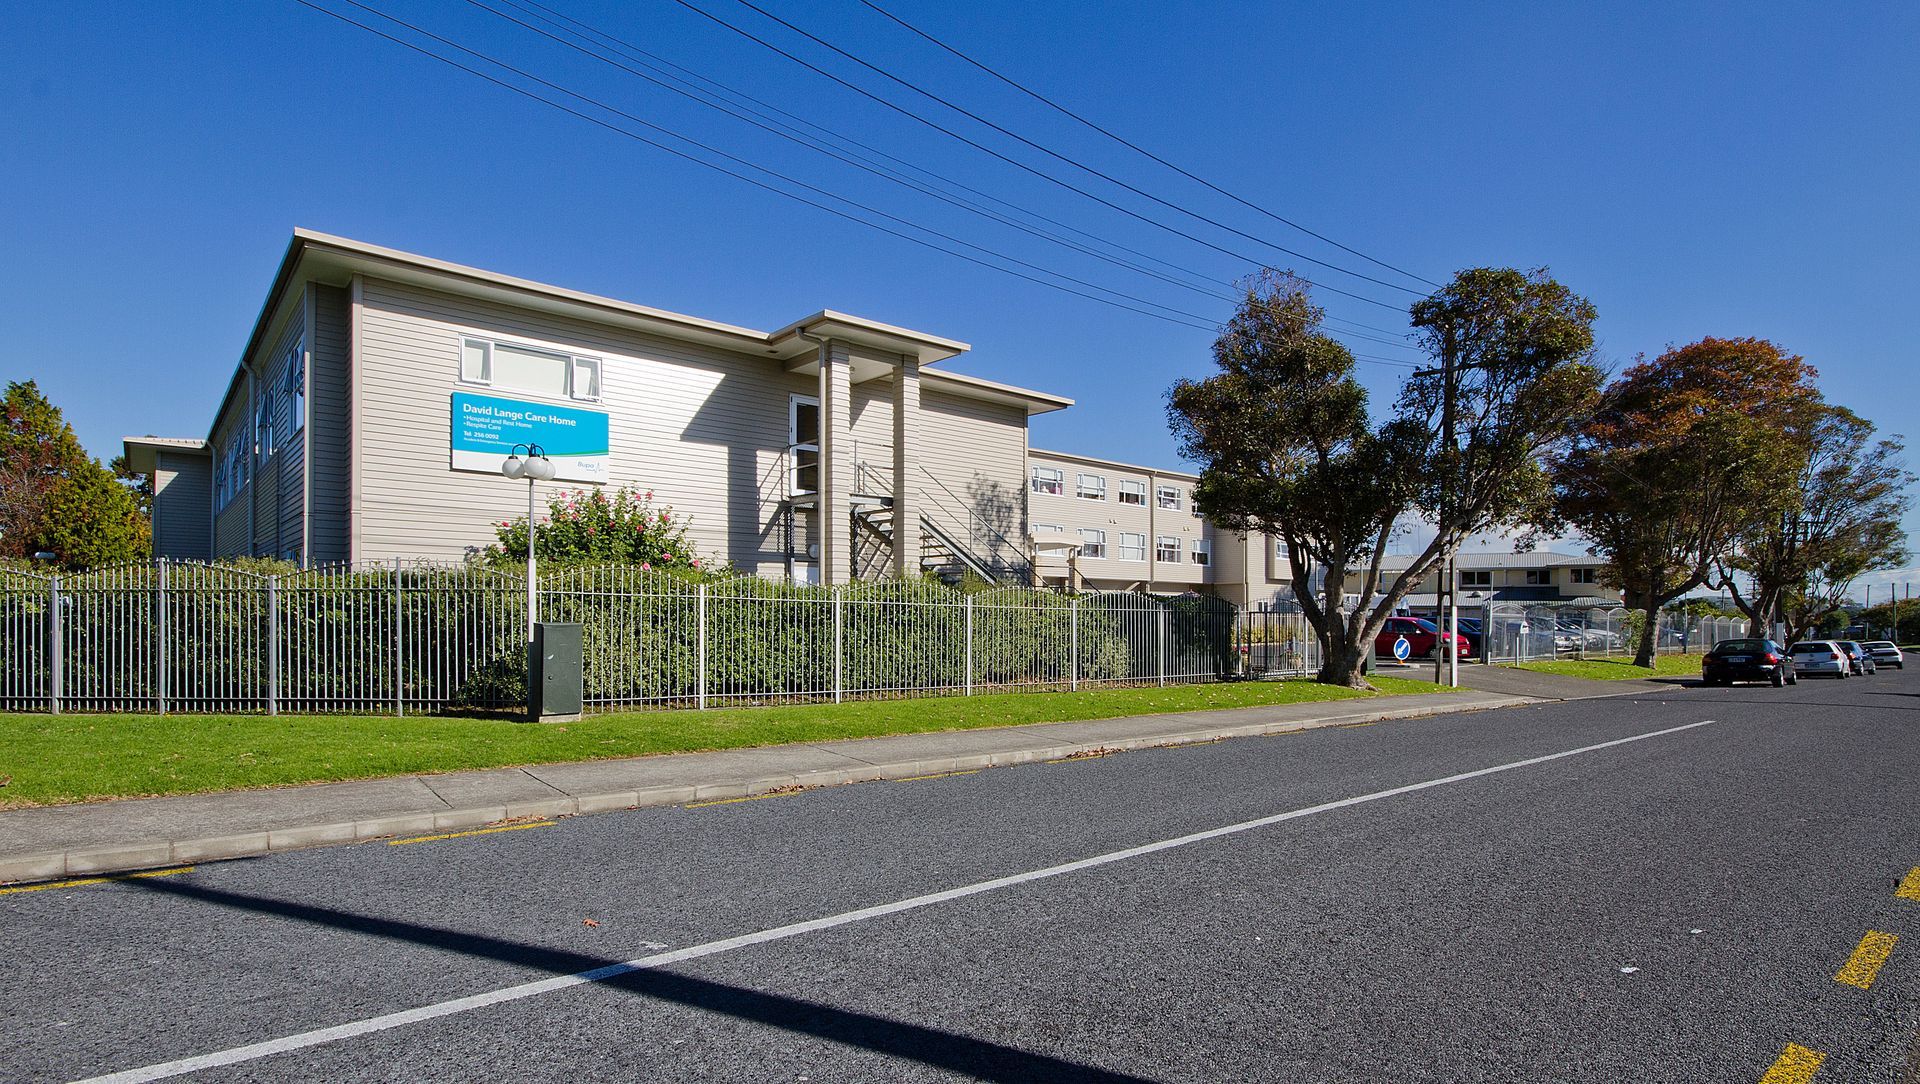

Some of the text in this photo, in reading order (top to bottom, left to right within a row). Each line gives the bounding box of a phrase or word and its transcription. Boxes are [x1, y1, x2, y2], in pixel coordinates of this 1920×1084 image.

[463, 403, 577, 427] David Lange Care Home
